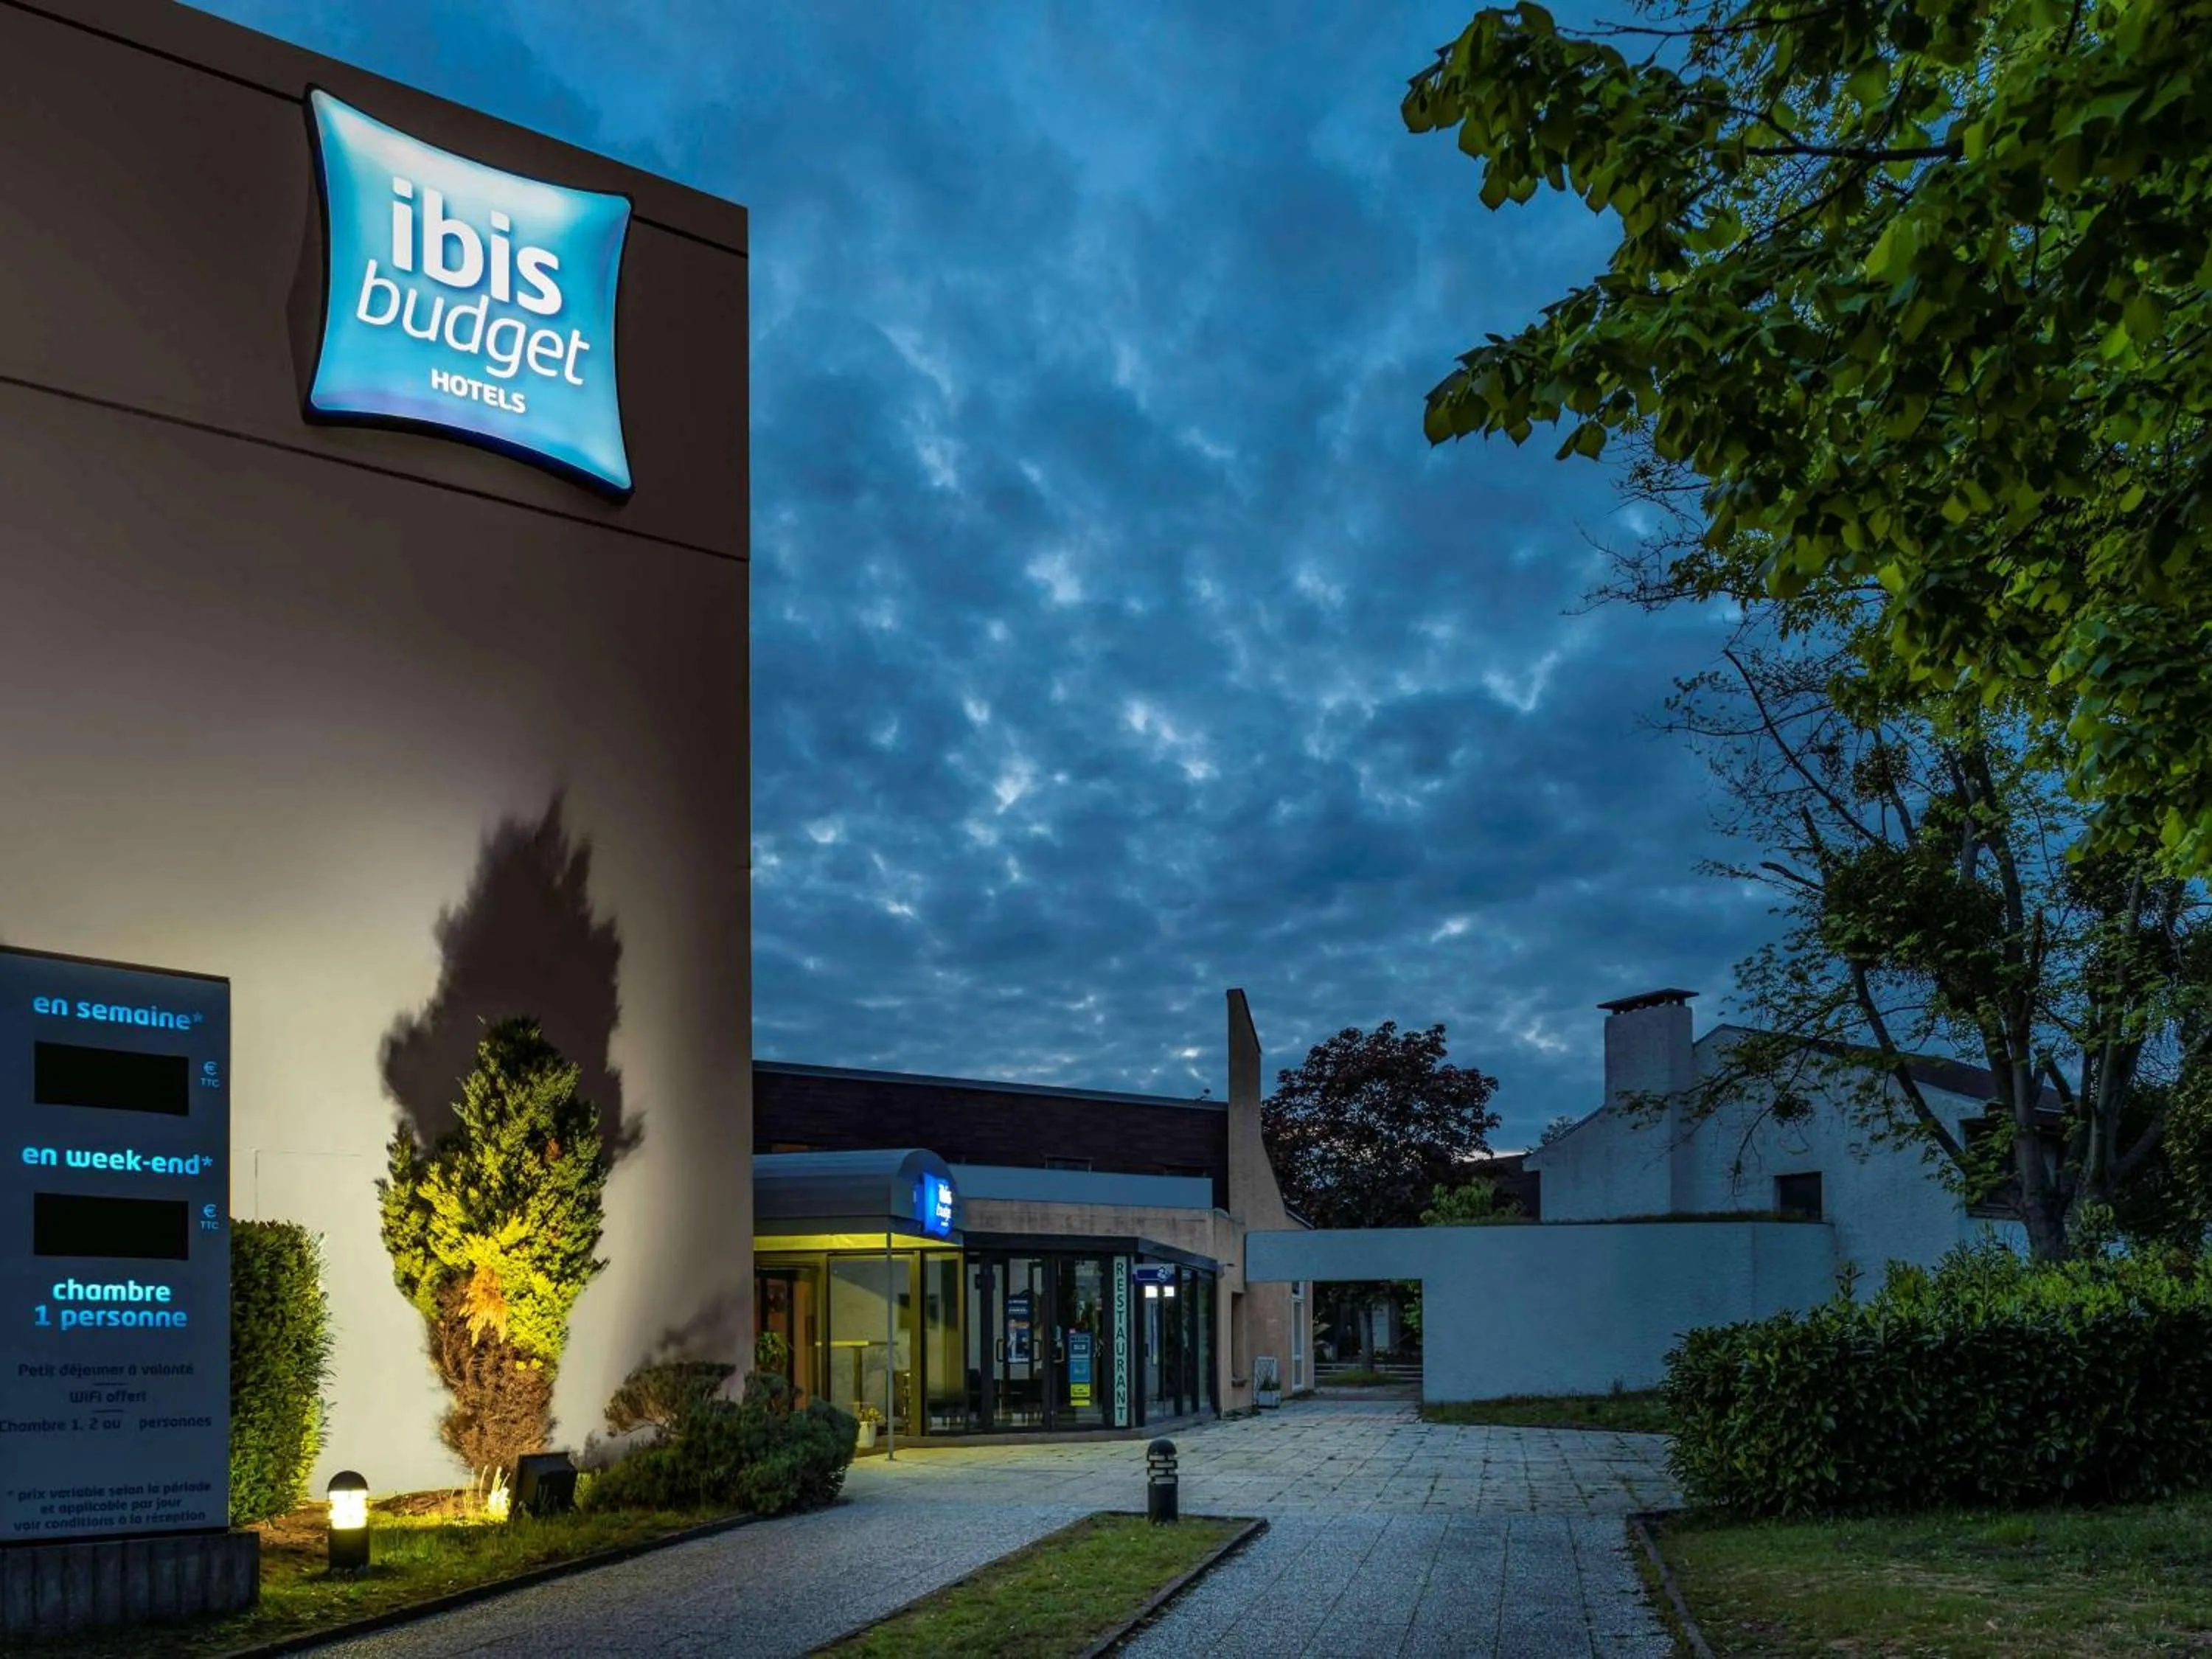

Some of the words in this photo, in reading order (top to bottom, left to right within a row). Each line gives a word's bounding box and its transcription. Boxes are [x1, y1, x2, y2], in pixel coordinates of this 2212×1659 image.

[392, 176, 562, 316] ibis
[355, 259, 590, 386] budget
[431, 369, 526, 414] HOTELS
[33, 996, 68, 1016] en
[202, 1061, 218, 1076] €
[200, 1077, 220, 1088] TTC
[22, 1147, 57, 1166] en
[203, 1203, 218, 1218] €
[200, 1220, 219, 1230] TTC
[52, 1279, 171, 1302] chambre
[35, 1304, 51, 1326] 1
[60, 1308, 188, 1330] personne
[1116, 1262, 1126, 1421] RESTAURANT
[18, 1363, 55, 1377] Petit
[141, 1363, 194, 1376] volonté
[69, 1391, 102, 1403] WiFi
[105, 1390, 147, 1402] offert
[0, 1418, 66, 1433] Chambre
[88, 1417, 98, 1430] 2
[102, 1419, 121, 1430] ou
[139, 1416, 212, 1431] personnes
